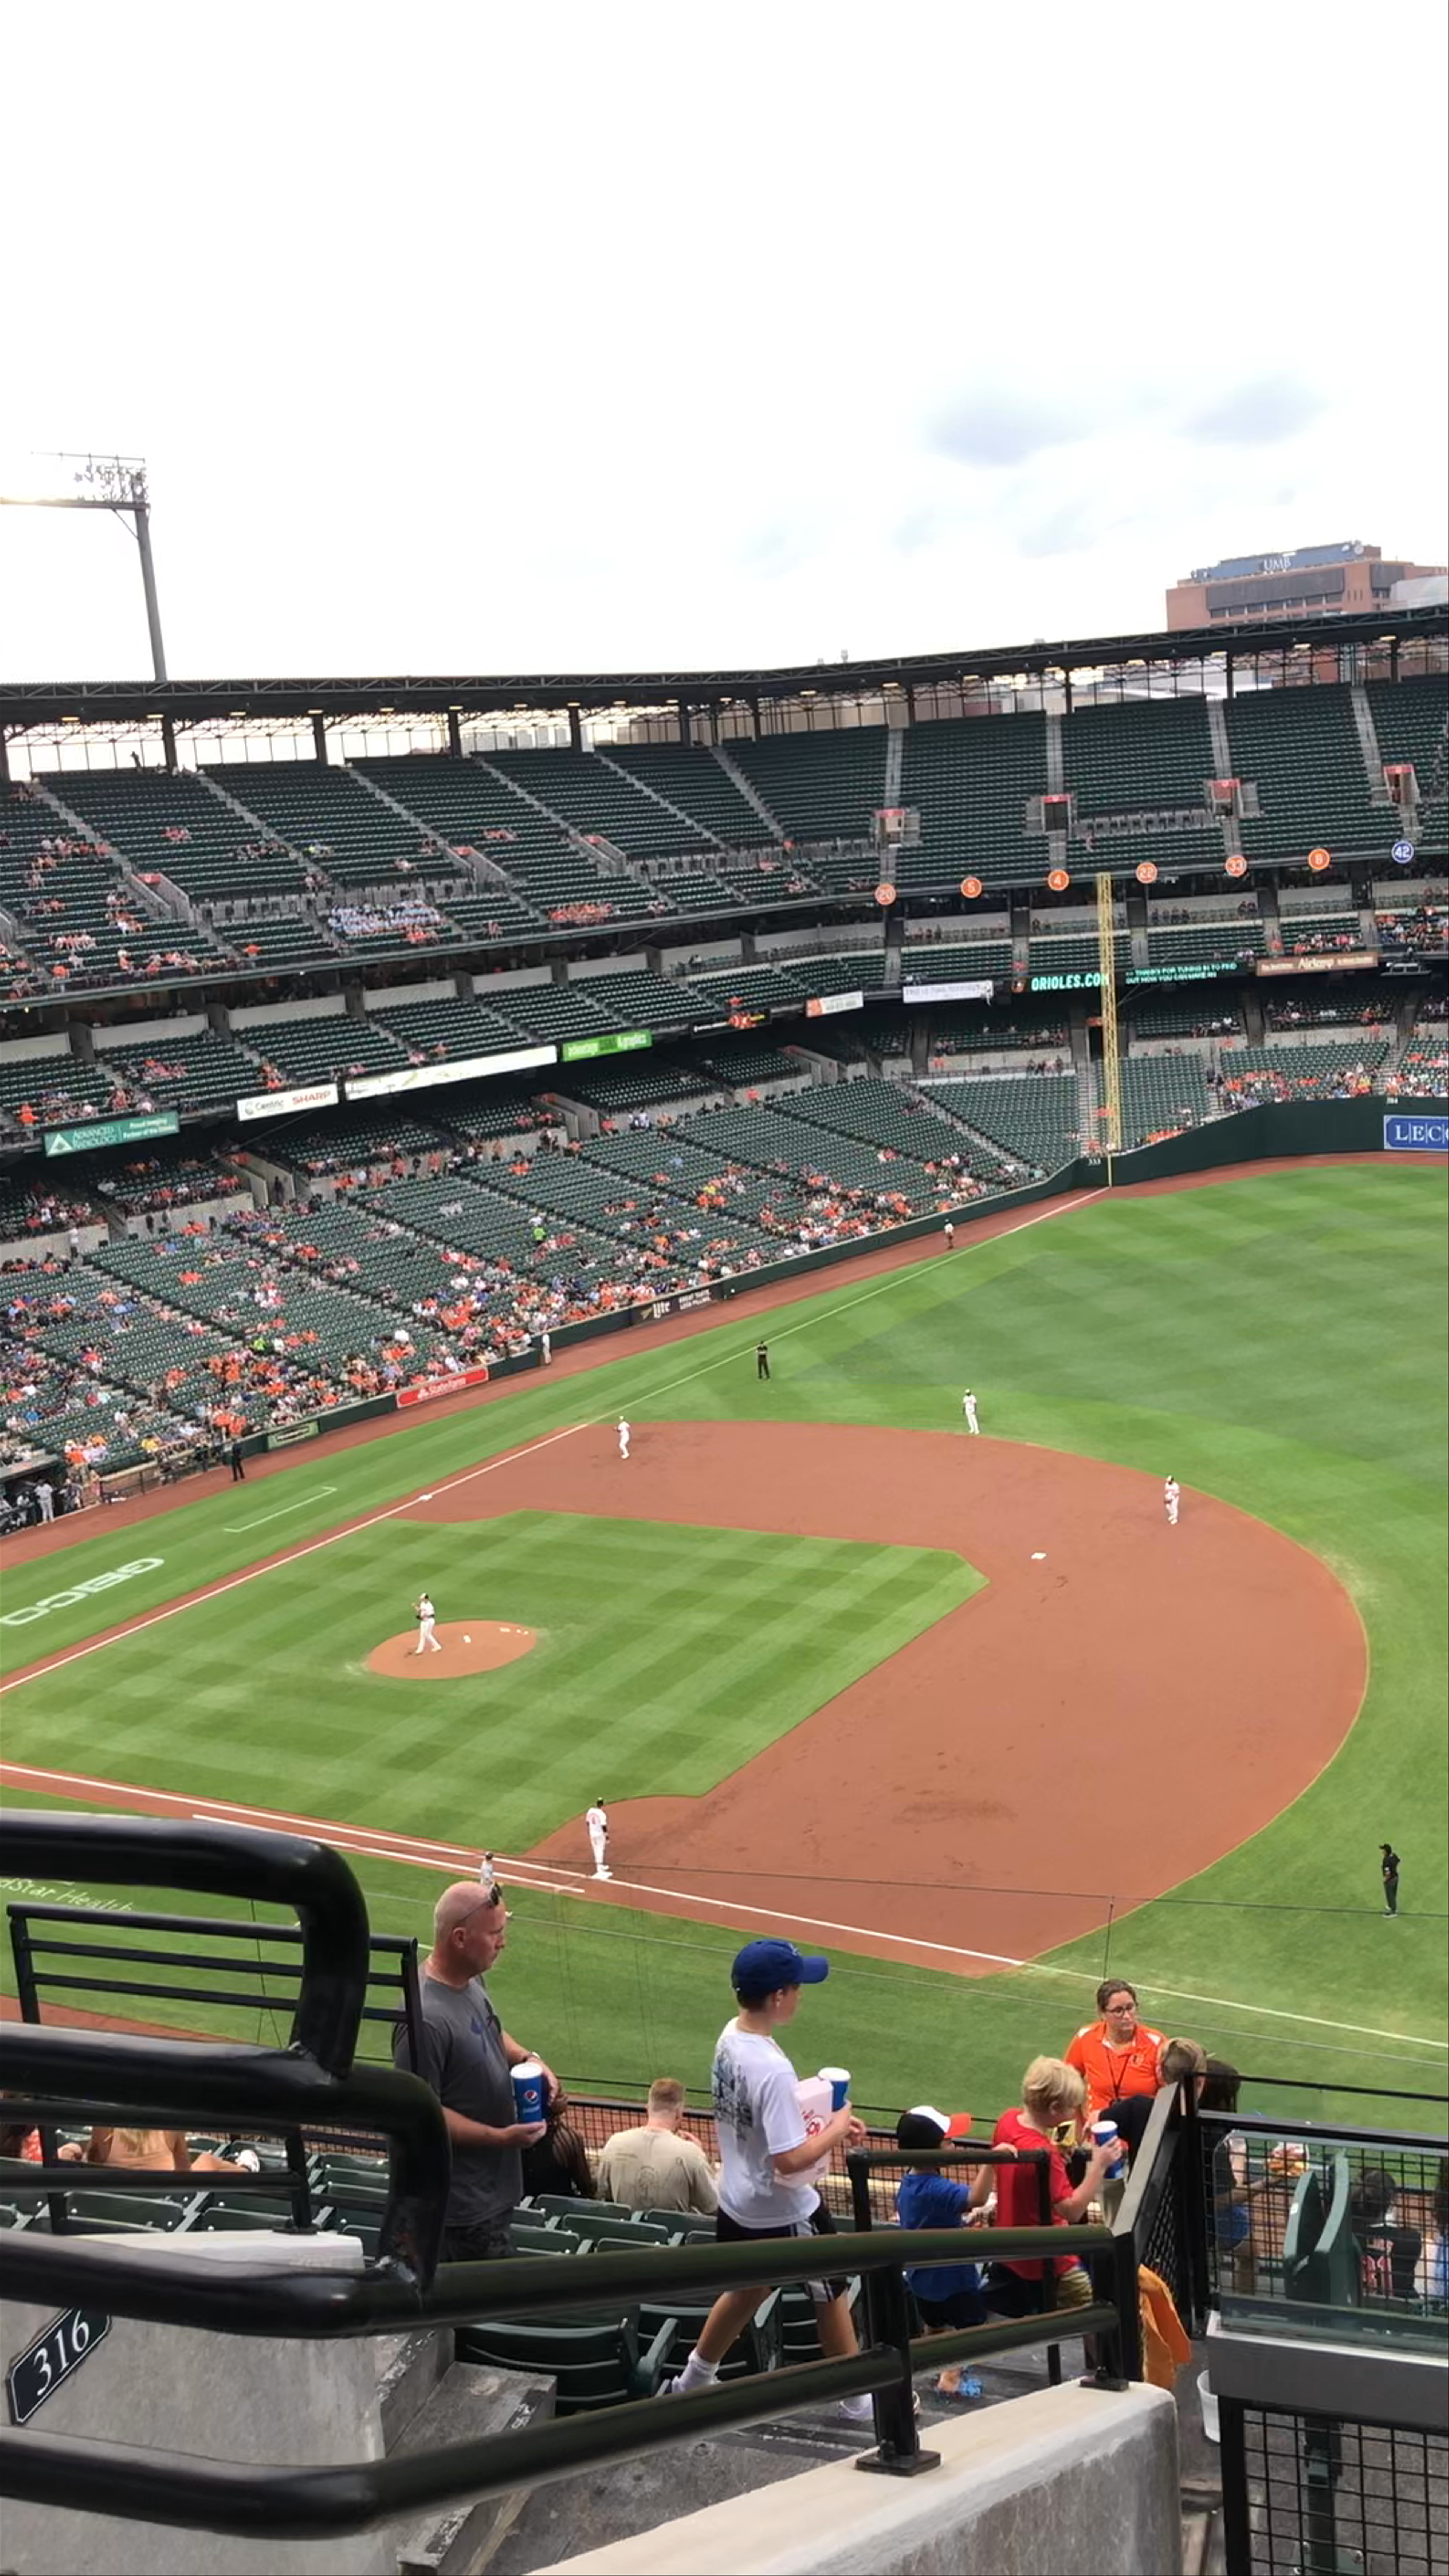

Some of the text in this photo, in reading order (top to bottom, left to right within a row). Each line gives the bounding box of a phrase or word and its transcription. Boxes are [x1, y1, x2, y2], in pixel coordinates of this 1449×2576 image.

[1264, 557, 1291, 570] UMB
[1395, 845, 1410, 859] 42
[1139, 867, 1154, 878] 22
[1229, 860, 1243, 873] 33
[1053, 875, 1061, 886] 4
[878, 887, 893, 901] 20
[967, 882, 975, 894] 5
[292, 1090, 331, 1105] SHARP
[74, 1126, 114, 1140] ADVANCED
[74, 1134, 118, 1150] RADIOLOGY
[652, 1301, 670, 1319] Lite
[34, 2310, 90, 2396] 316
